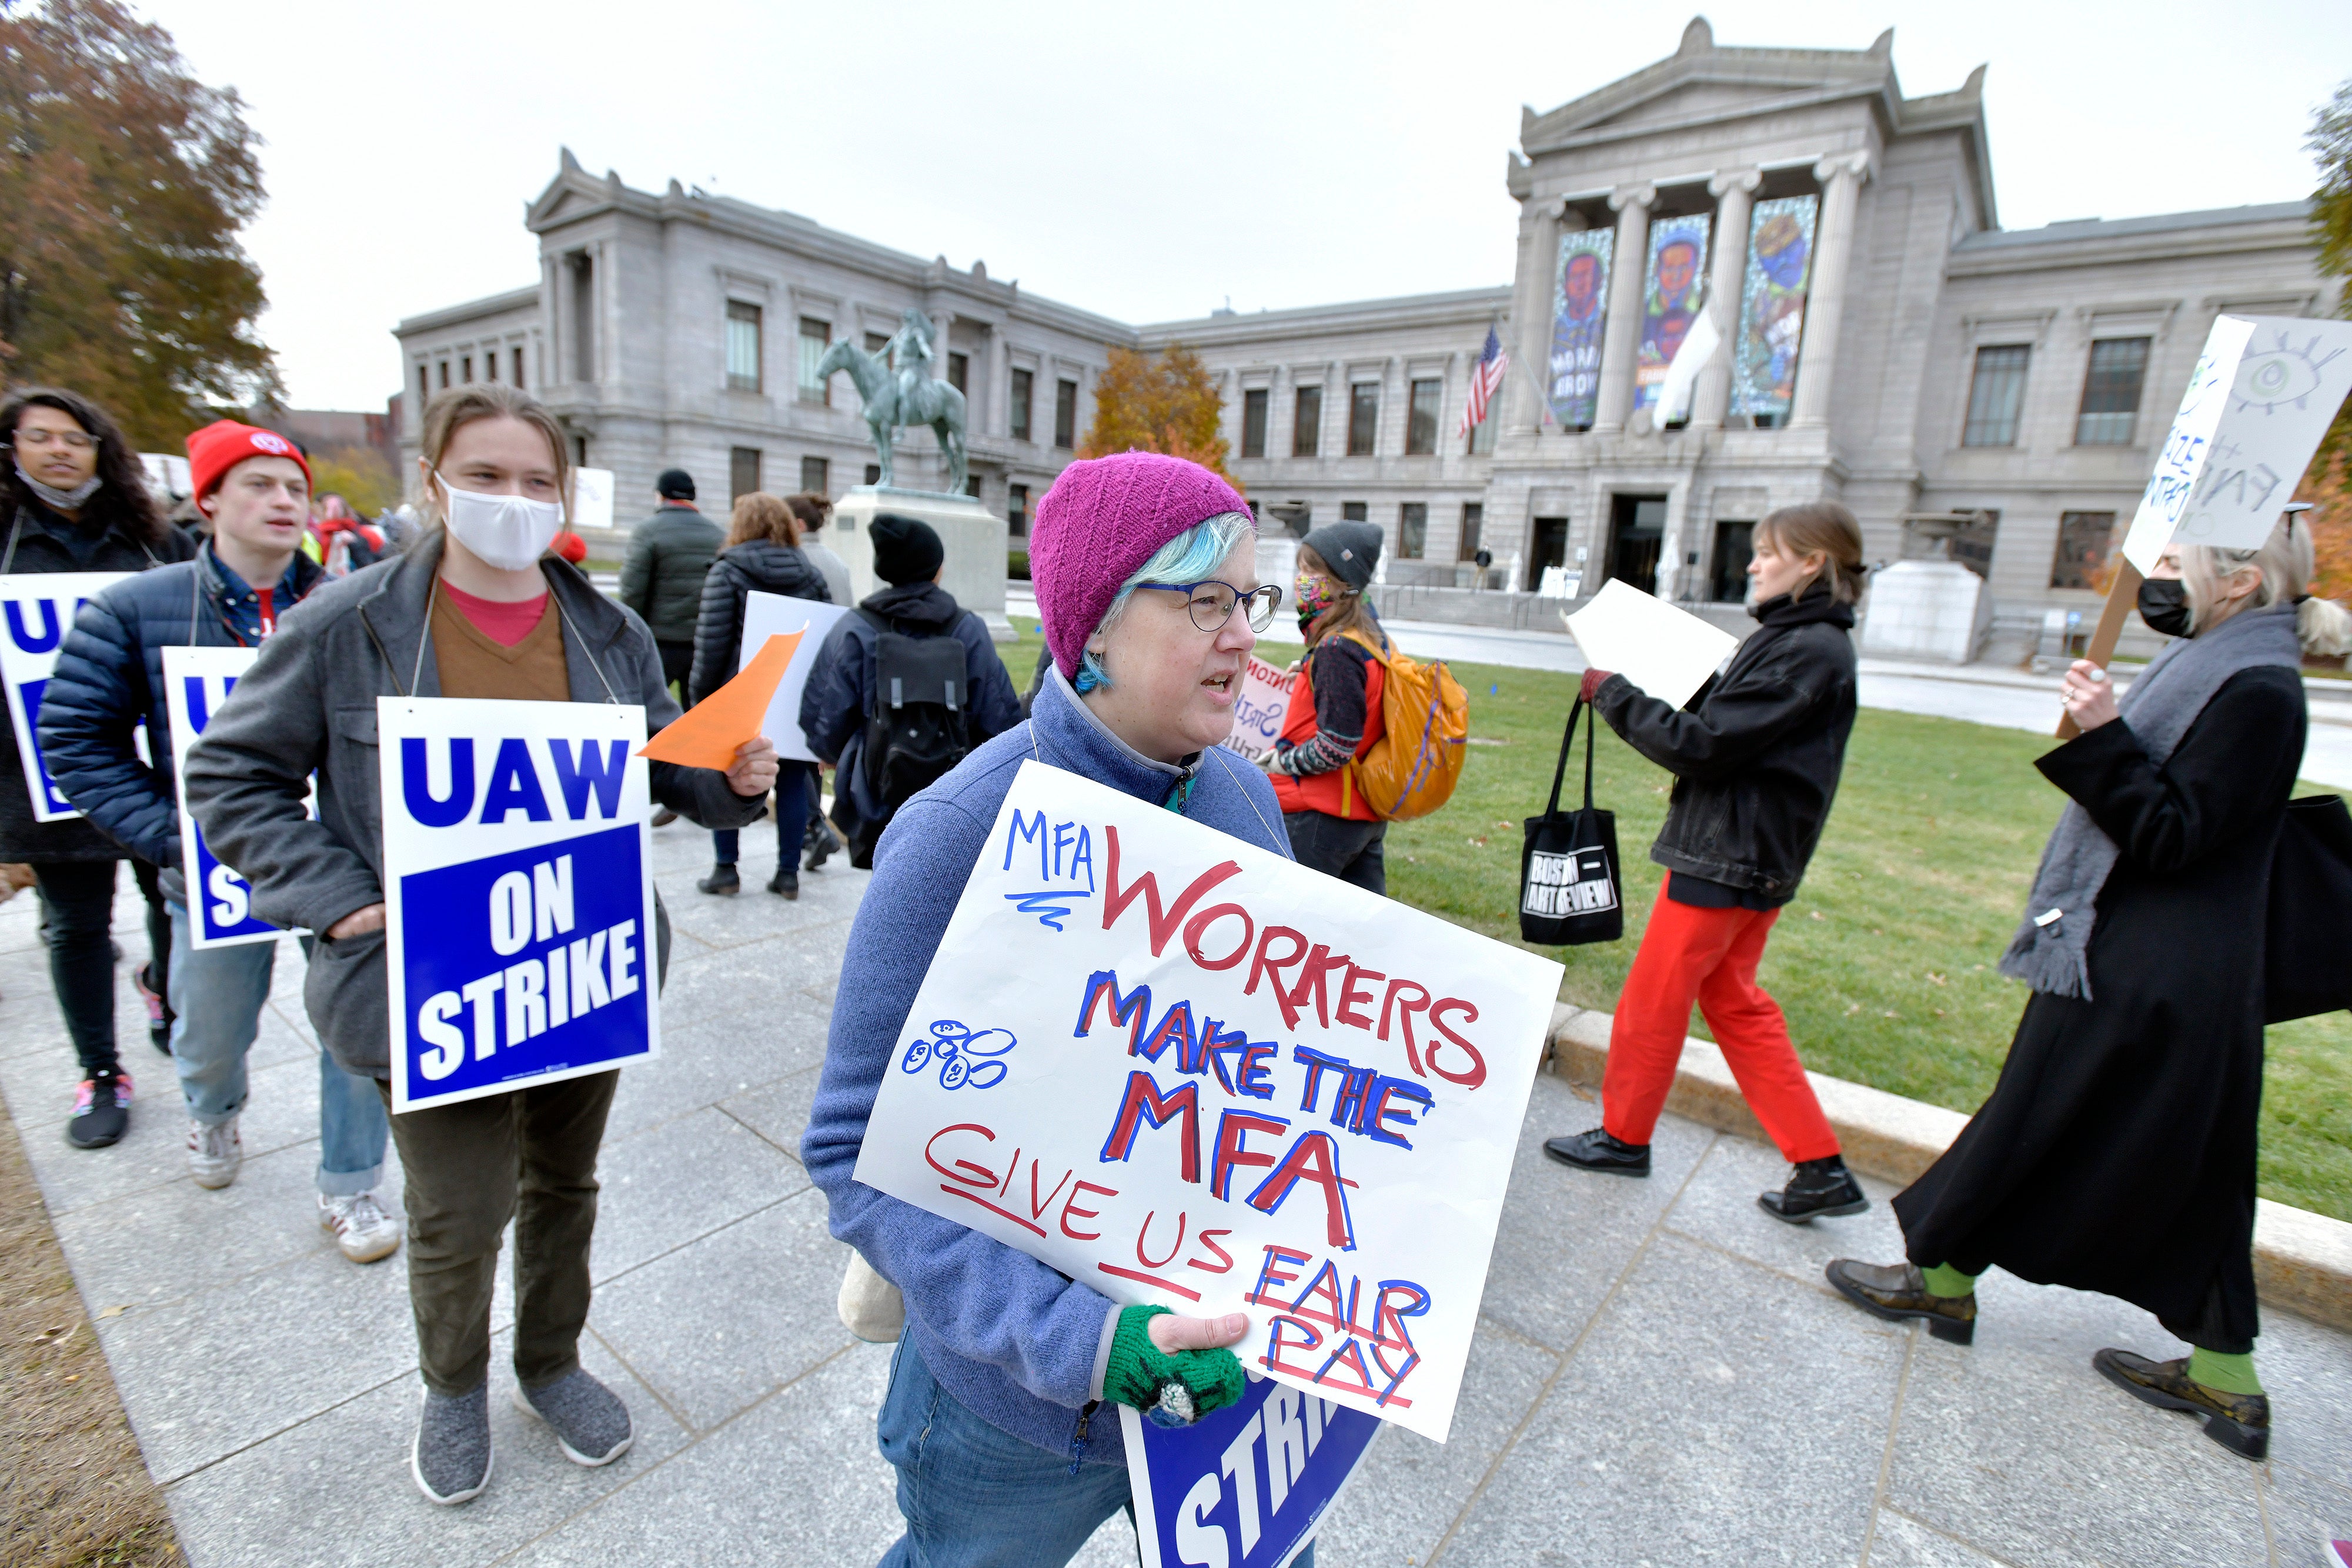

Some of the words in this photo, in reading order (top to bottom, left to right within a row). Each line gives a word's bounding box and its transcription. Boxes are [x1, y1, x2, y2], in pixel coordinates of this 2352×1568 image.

[400, 737, 630, 827] UAW
[489, 854, 575, 956] ON
[1003, 808, 1094, 892] MFA
[1102, 825, 1486, 1091] WORKERS
[1526, 883, 1558, 914] ART
[417, 918, 640, 1081] STRIKE
[1074, 970, 1278, 1099] MAKE
[1294, 1044, 1435, 1151] THE
[925, 1124, 1119, 1241] GIVE
[1136, 1211, 1234, 1273] US
[1251, 1245, 1431, 1355] FAIR
[1100, 1071, 1359, 1251] MFA
[1267, 1316, 1420, 1407] PAY
